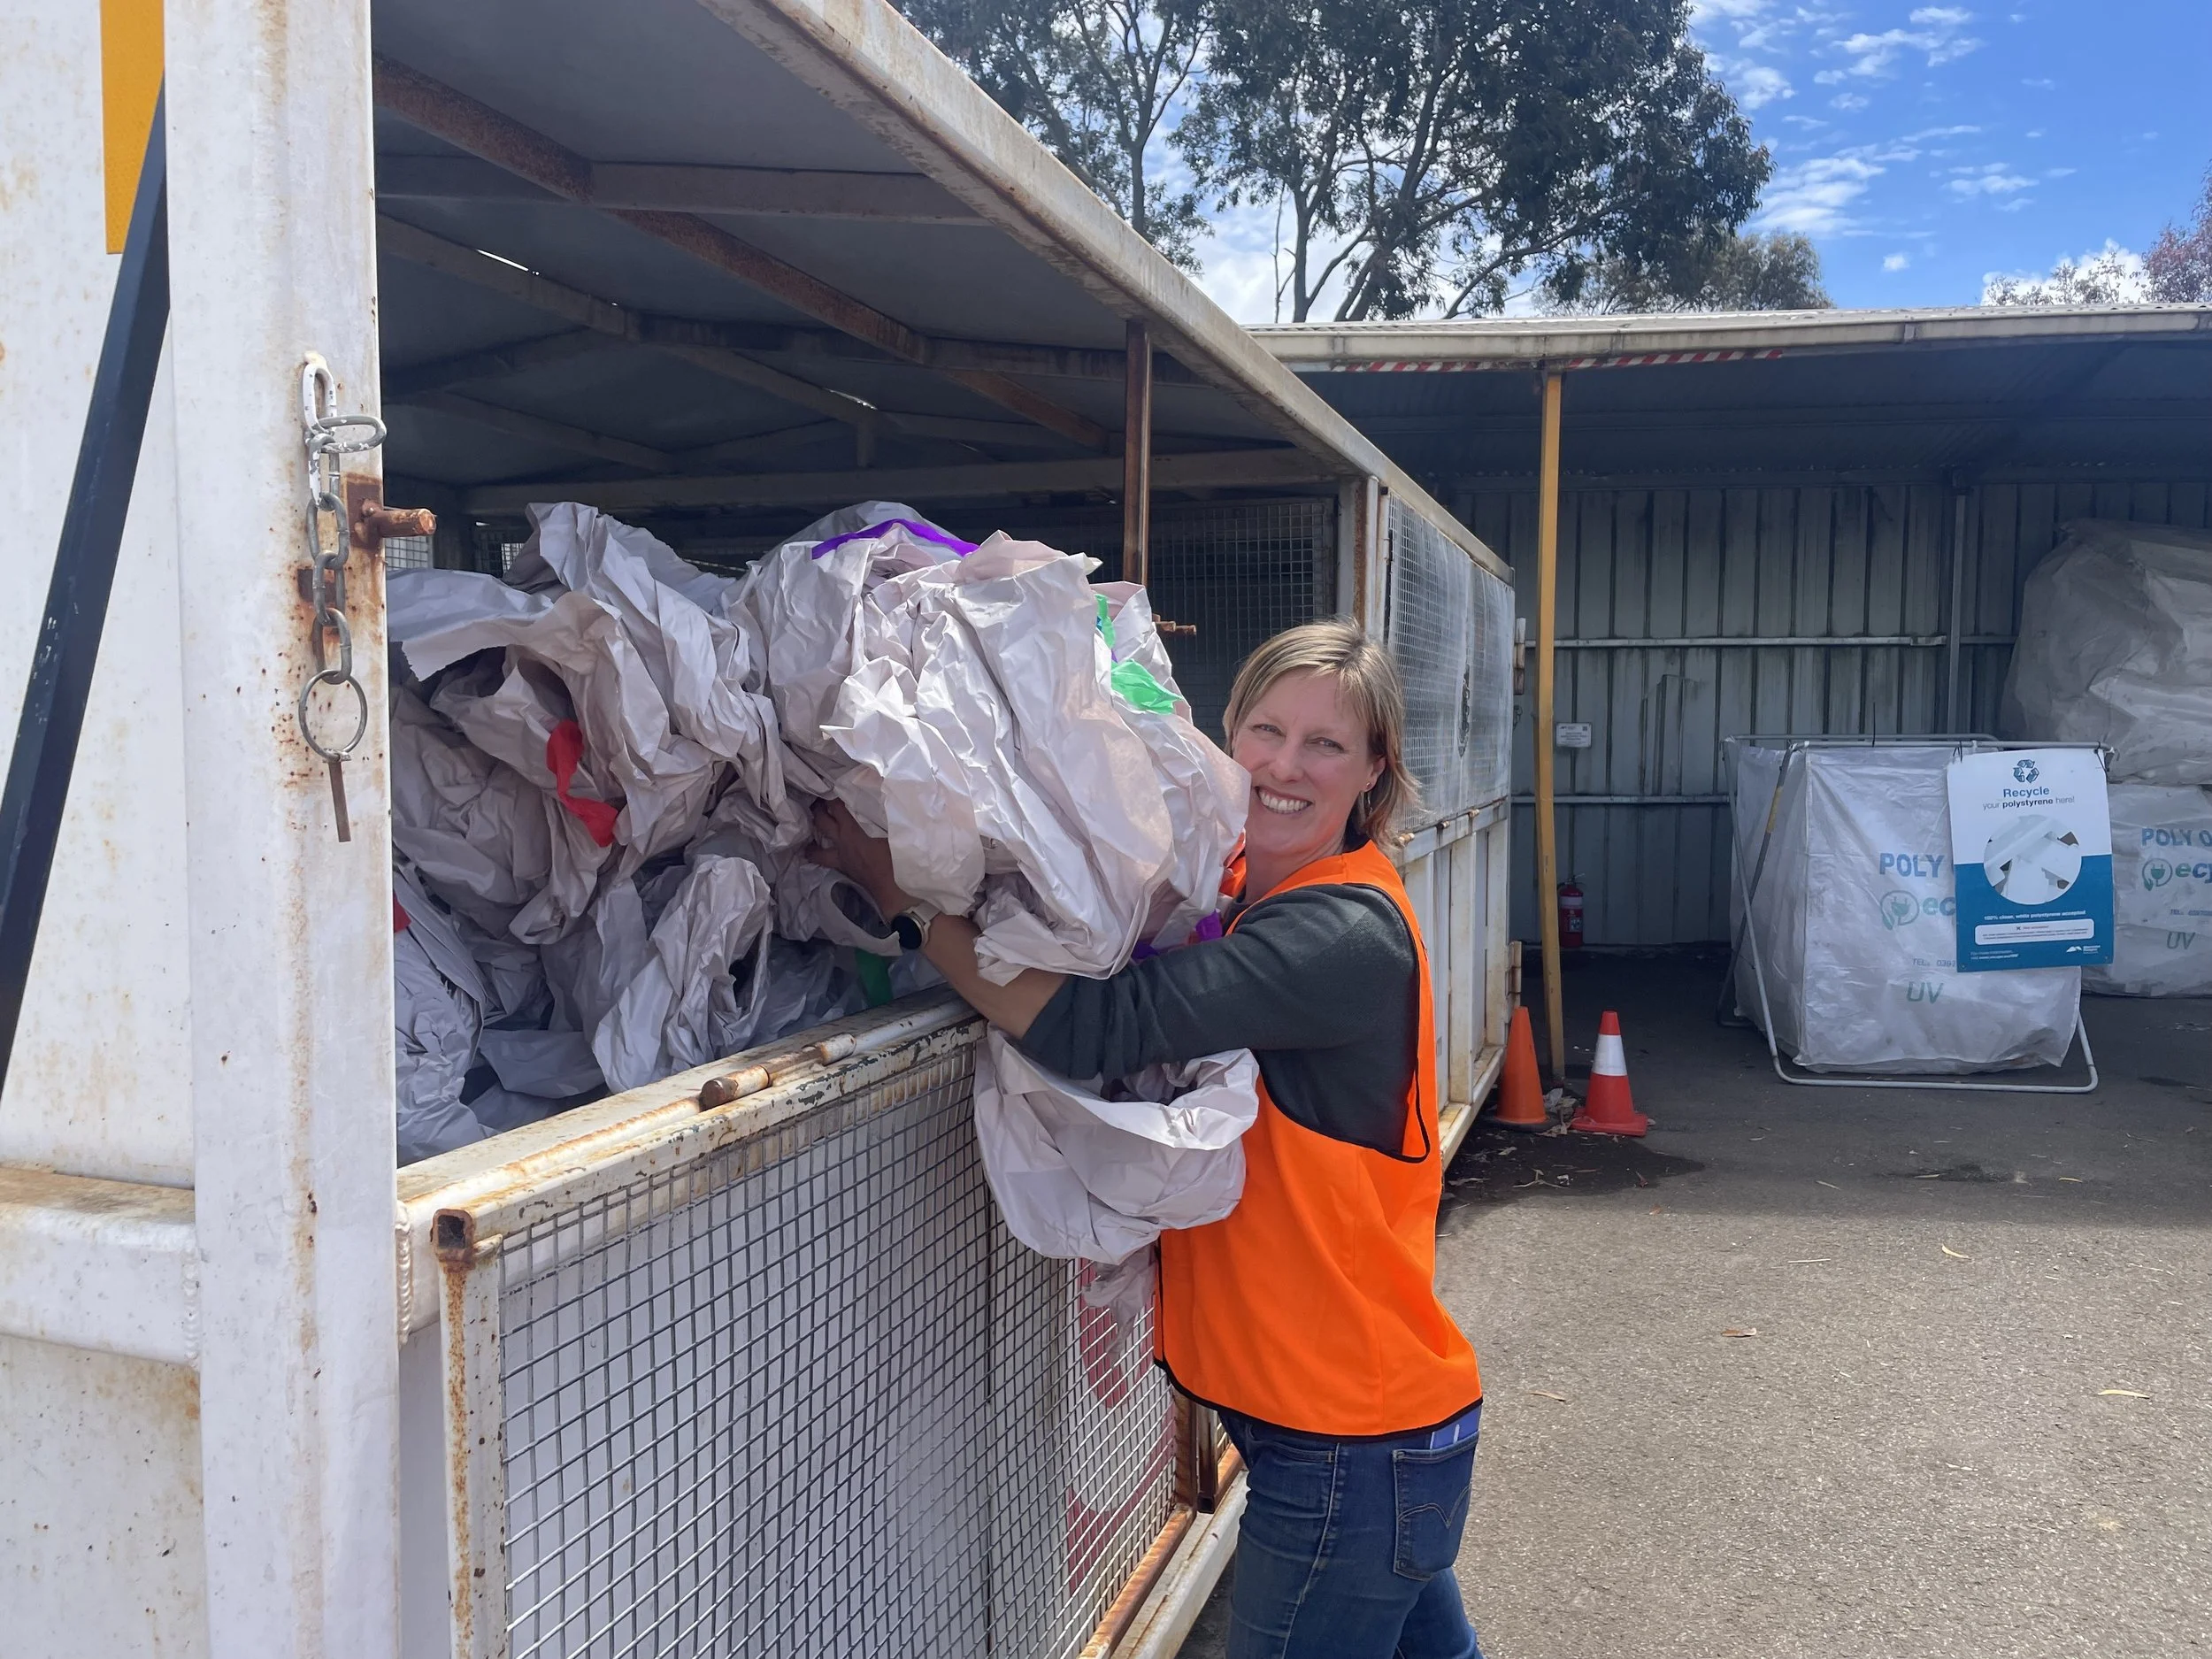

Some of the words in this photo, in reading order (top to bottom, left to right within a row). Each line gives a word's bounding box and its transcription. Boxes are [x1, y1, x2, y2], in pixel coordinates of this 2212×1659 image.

[2003, 787, 2049, 798] Recycle
[1983, 802, 2000, 810] your
[2002, 799, 2053, 809] polystyrene
[2141, 828, 2193, 847] POLY
[1879, 853, 1945, 878] POLY
[2166, 932, 2195, 949] UV
[1907, 981, 1944, 1004] UV
